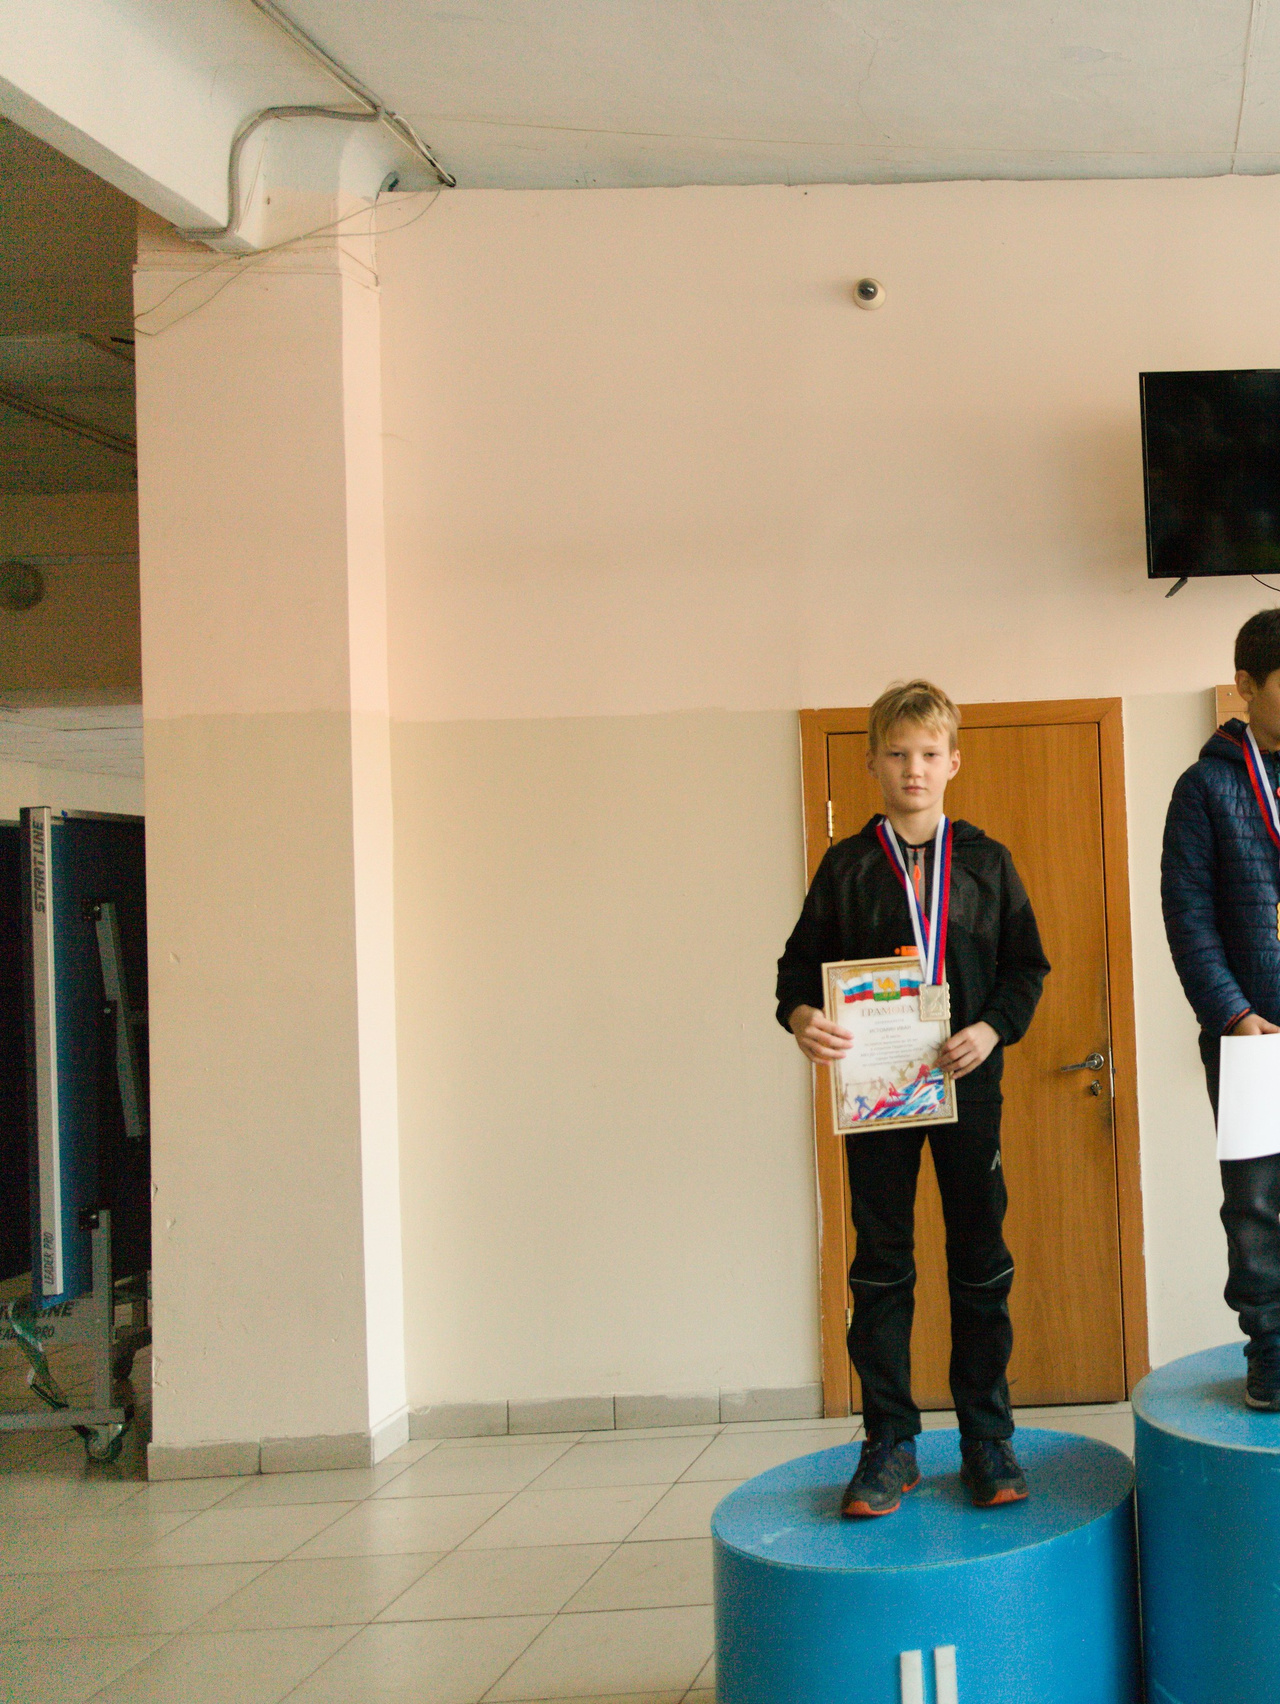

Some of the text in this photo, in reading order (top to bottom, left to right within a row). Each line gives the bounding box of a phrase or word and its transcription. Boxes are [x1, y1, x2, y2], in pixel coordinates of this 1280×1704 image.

[32, 818, 46, 913] START LINE
[861, 1005, 915, 1017] ГРАМОТА
[43, 1231, 54, 1285] LEADER PRO
